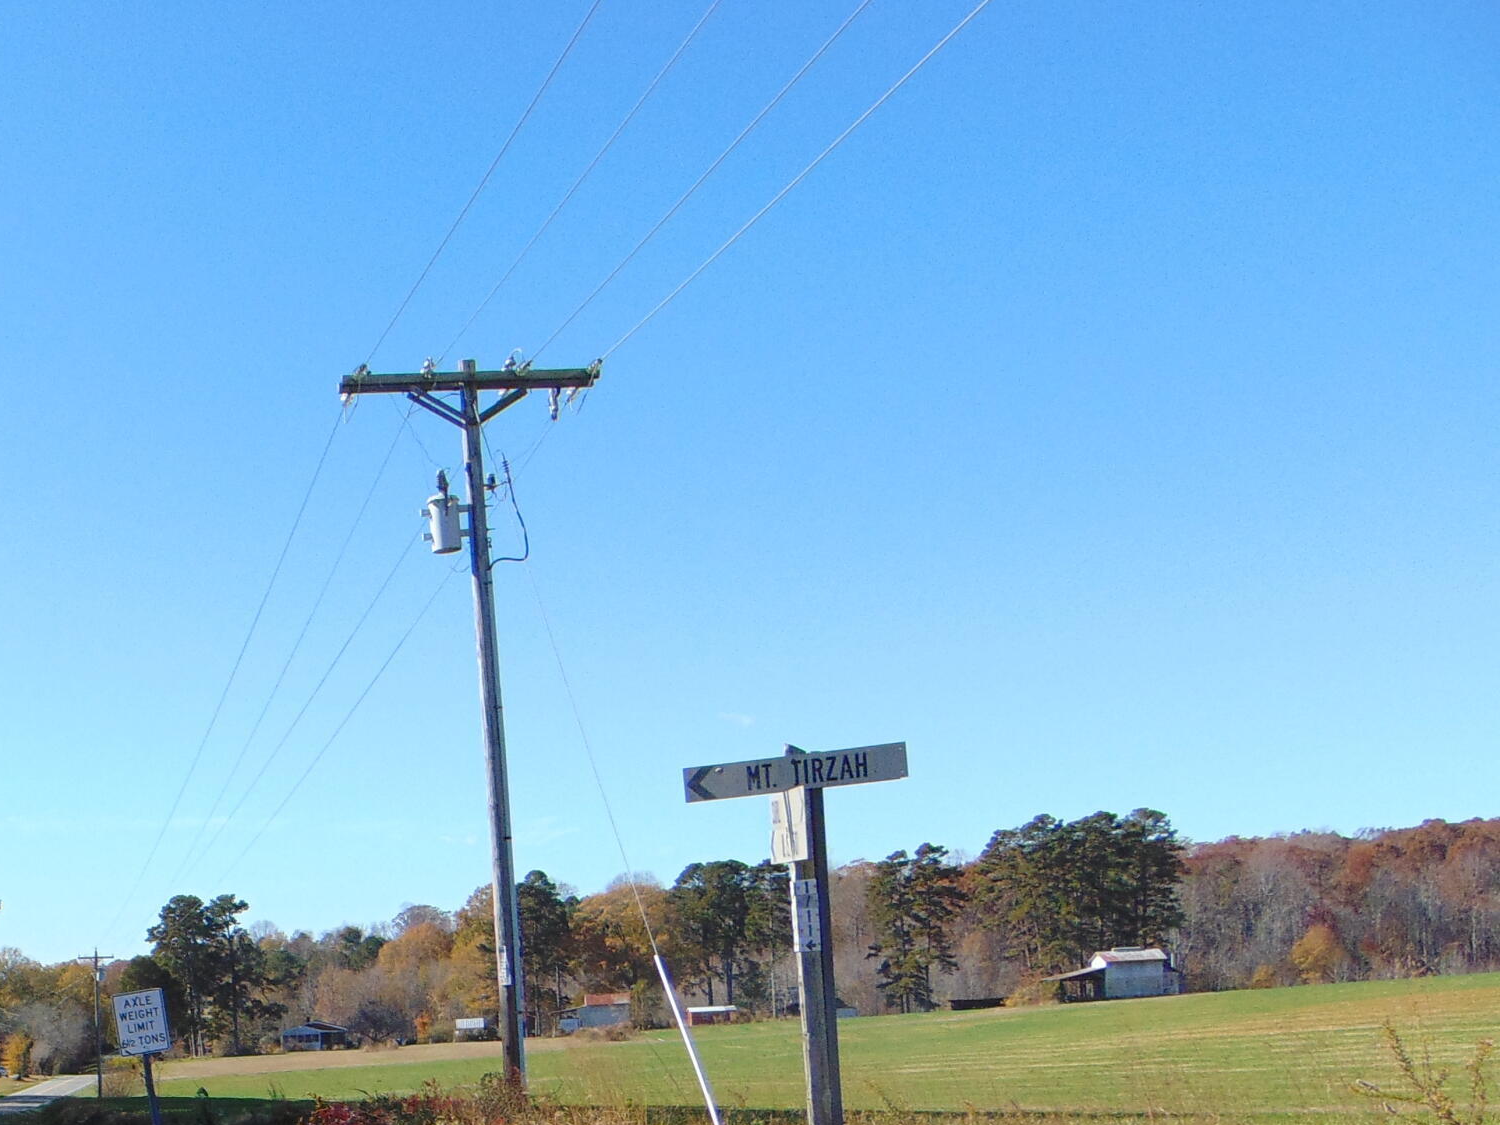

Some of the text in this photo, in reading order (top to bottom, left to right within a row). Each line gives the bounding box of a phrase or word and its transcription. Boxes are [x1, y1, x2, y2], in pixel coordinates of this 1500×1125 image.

[746, 752, 868, 791] MT. TIRZAH
[124, 995, 153, 1009] AXLE
[119, 1007, 159, 1022] WEIGHT
[127, 1020, 155, 1034] LIMIT
[138, 1032, 166, 1046] TONS
